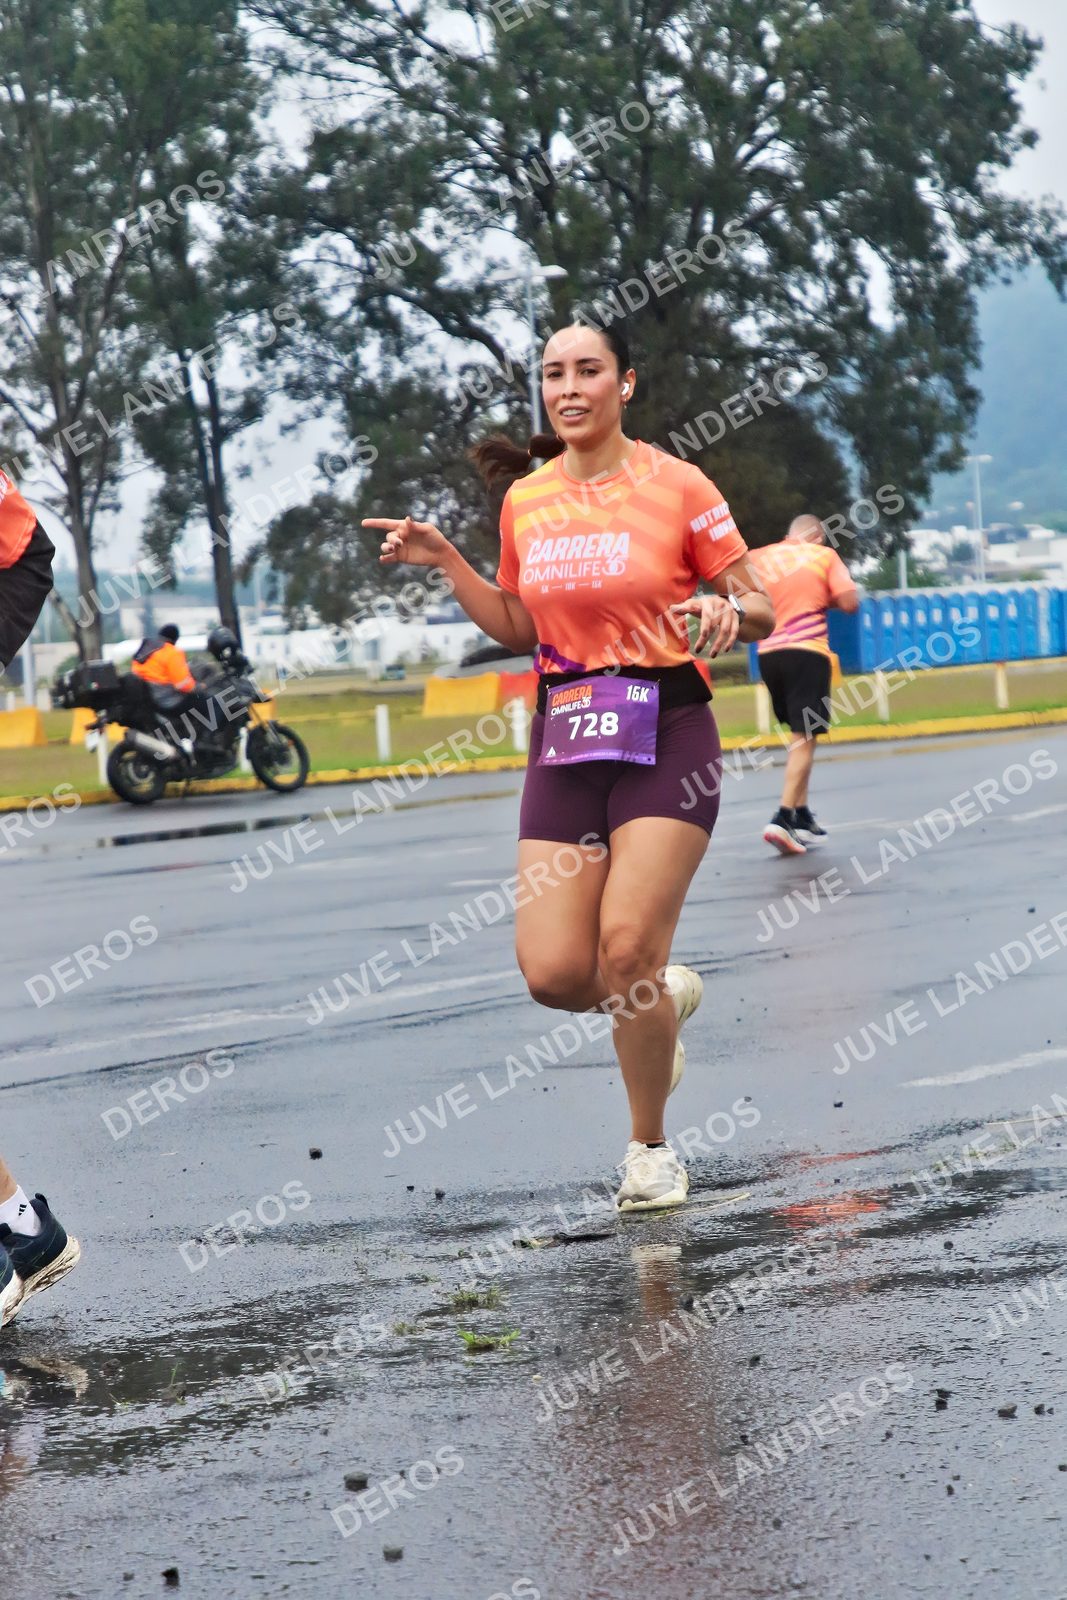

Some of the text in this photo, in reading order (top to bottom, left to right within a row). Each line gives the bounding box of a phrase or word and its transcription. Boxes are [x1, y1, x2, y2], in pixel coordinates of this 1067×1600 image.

[526, 532, 630, 565] CARRERA
[523, 560, 602, 585] OMNILIFE
[552, 685, 592, 707] CARRERA
[551, 702, 582, 716] OMNILIFE
[568, 712, 619, 740] 728
